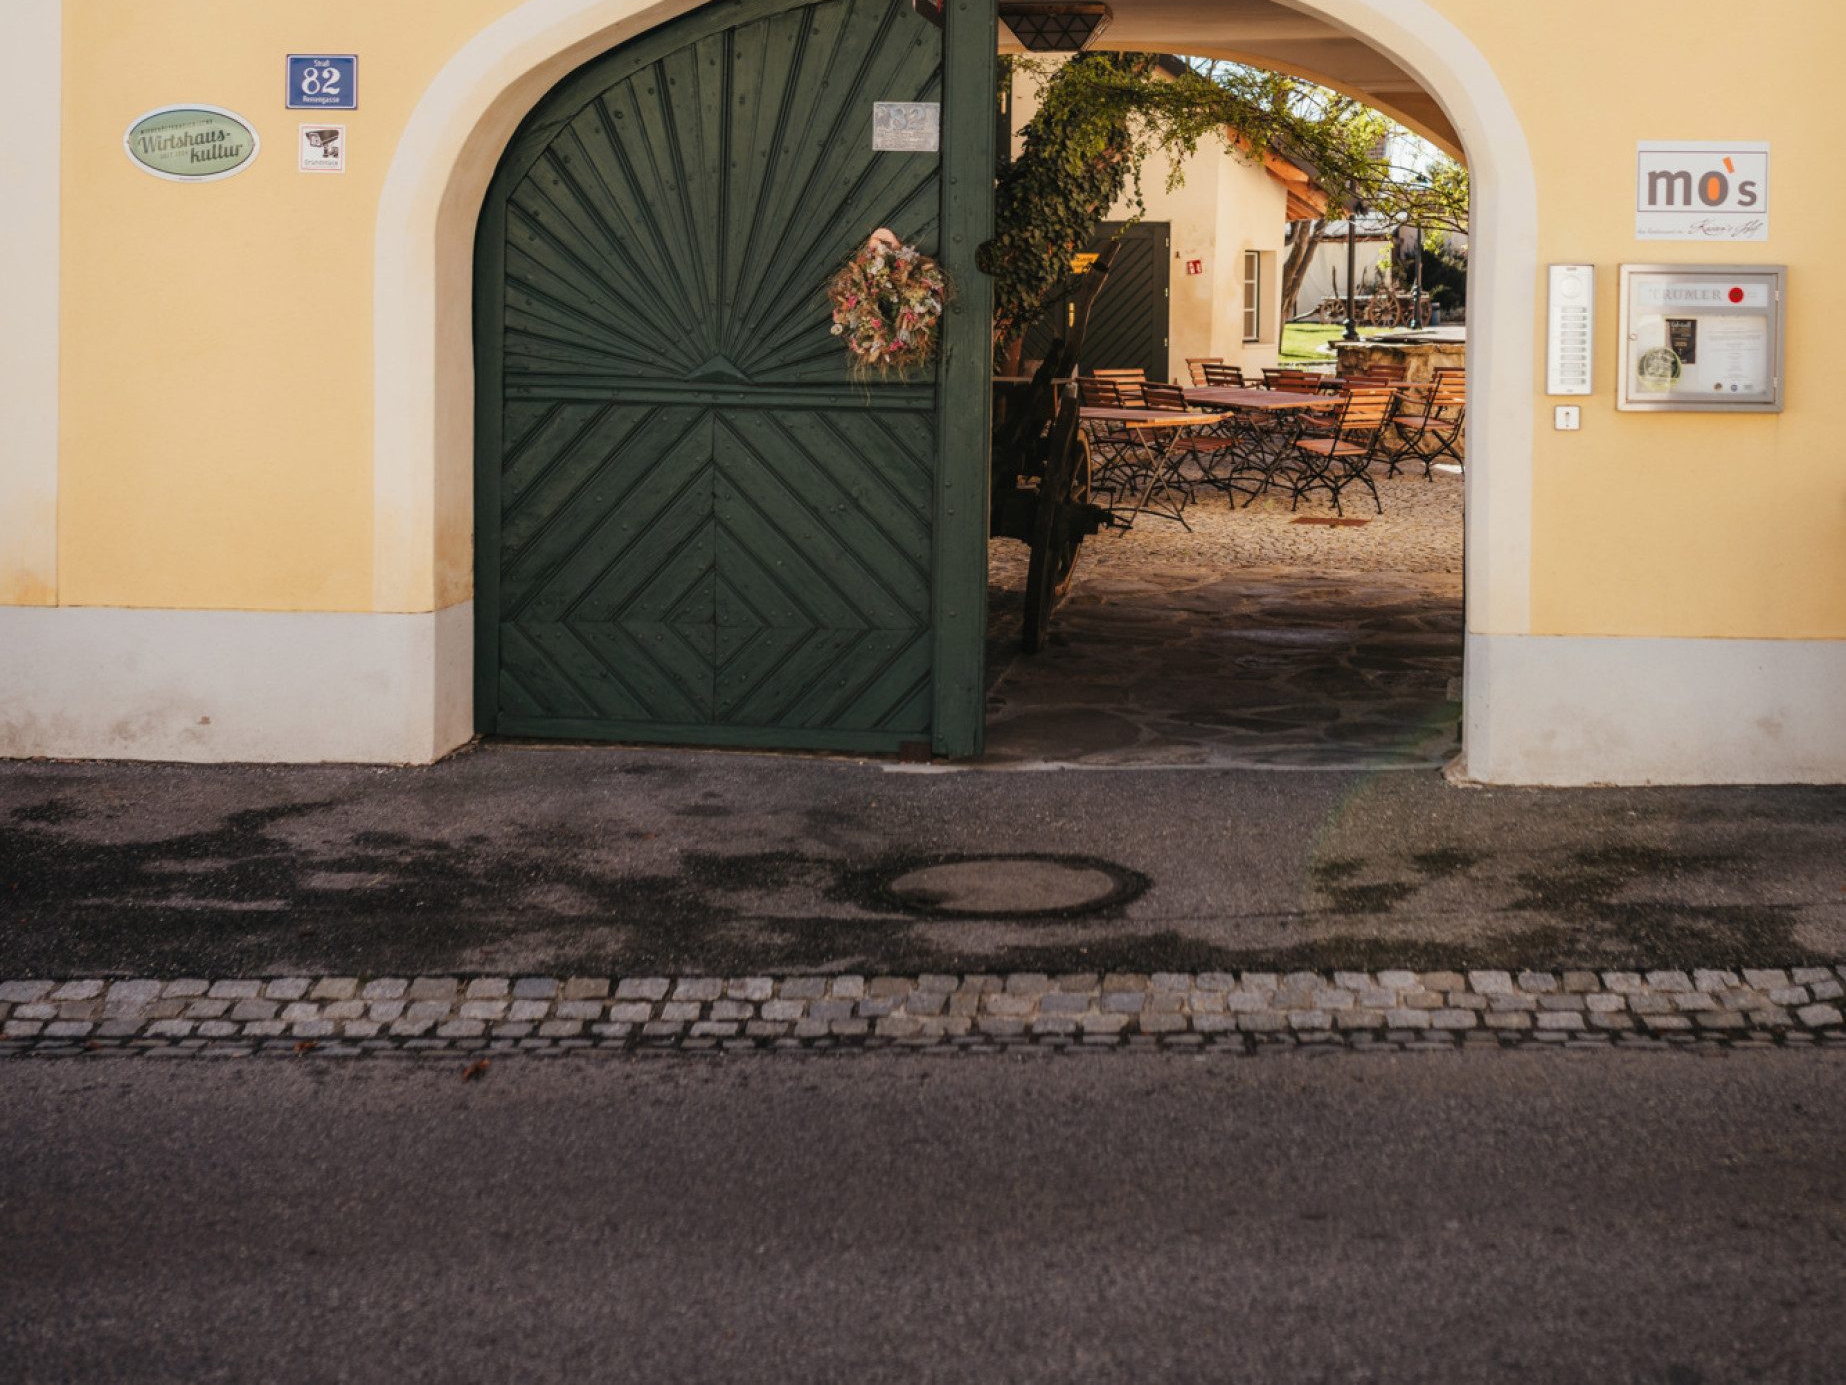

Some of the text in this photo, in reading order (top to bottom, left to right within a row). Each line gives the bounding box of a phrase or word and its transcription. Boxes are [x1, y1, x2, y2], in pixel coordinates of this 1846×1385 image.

[302, 67, 340, 95] 82
[138, 129, 231, 154] Wirtshaus-
[190, 144, 243, 163] kultur
